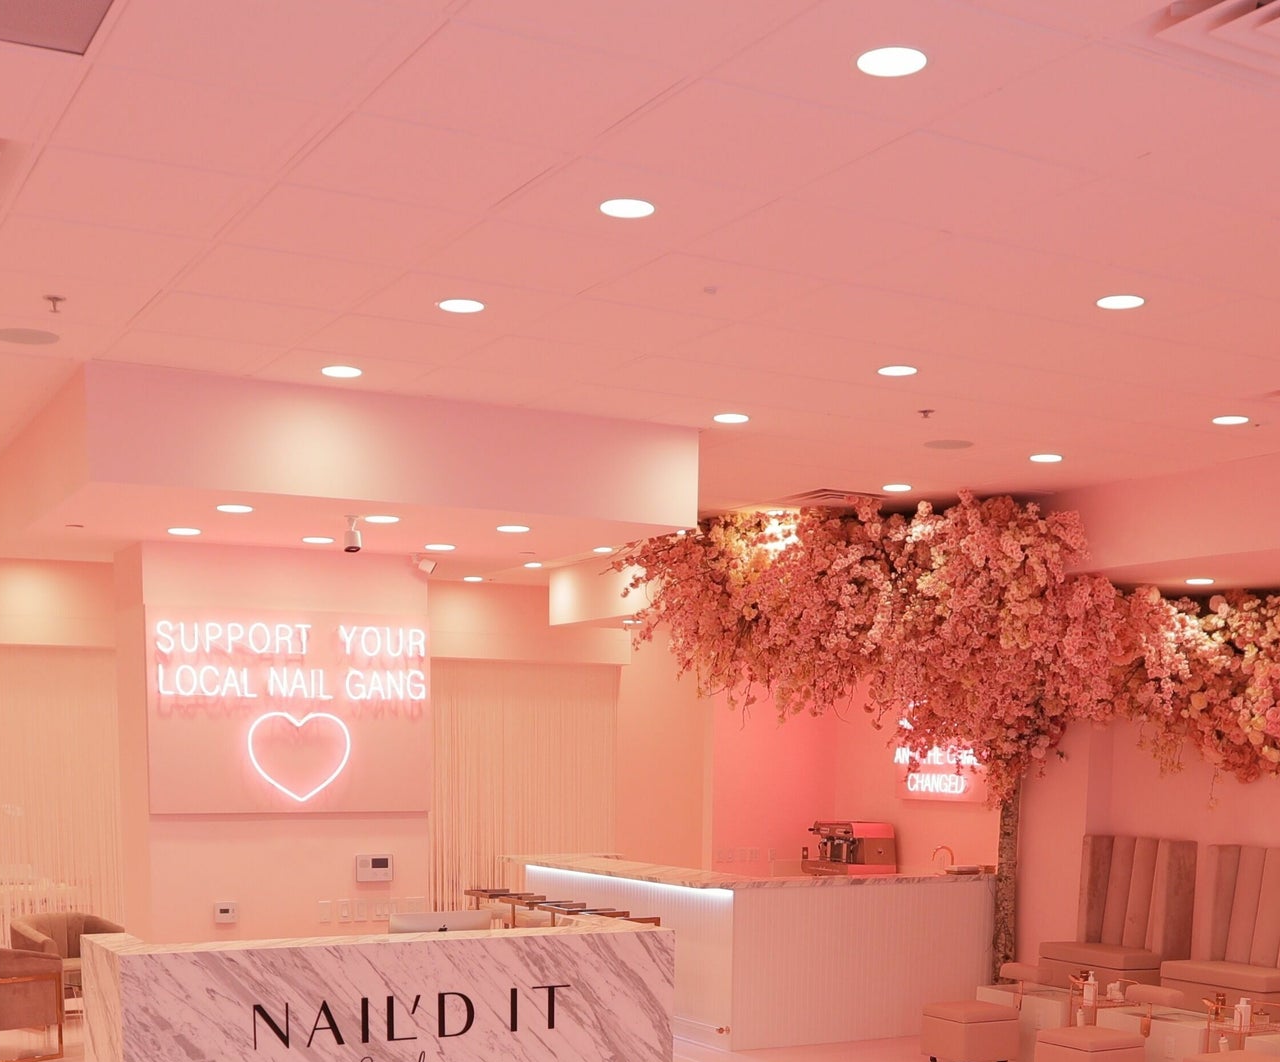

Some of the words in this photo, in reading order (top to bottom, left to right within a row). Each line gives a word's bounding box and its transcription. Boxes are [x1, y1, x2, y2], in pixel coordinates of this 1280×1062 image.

[156, 620, 311, 655] SUPPORT
[338, 624, 426, 657] YOUR
[157, 664, 257, 698] LOCAL
[268, 667, 333, 700] NAIL
[345, 668, 426, 700] GANG
[907, 773, 965, 794] CHANGED
[253, 990, 475, 1050] NAIL'D
[509, 984, 571, 1032] IT
